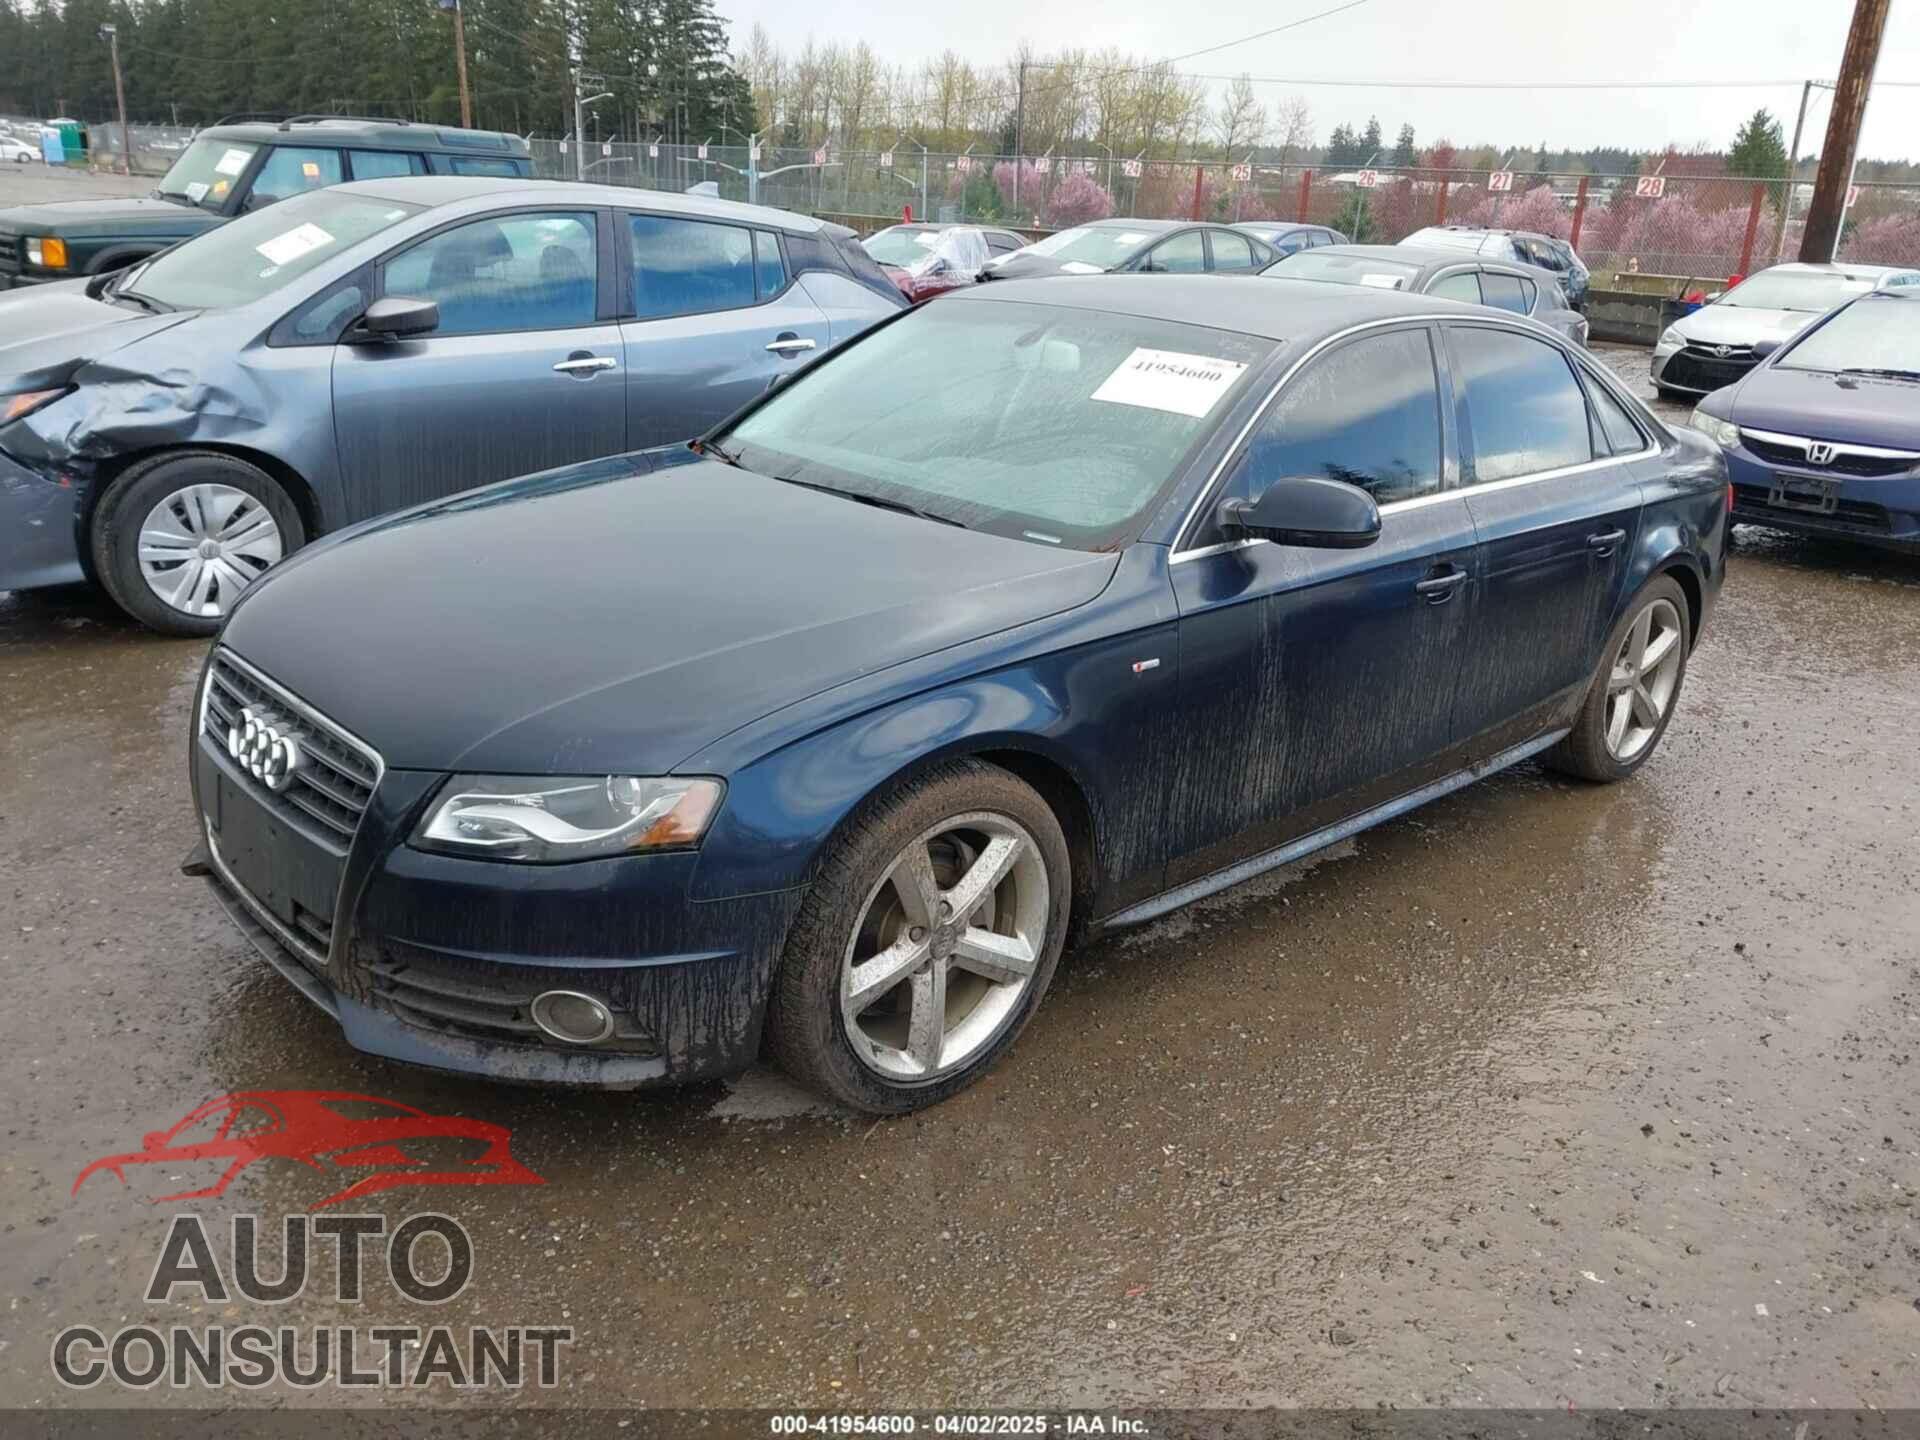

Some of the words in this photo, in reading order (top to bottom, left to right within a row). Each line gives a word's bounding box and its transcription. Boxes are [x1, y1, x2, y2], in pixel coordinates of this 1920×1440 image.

[1235, 166, 1249, 180] 25
[1360, 171, 1375, 186] 26
[1492, 173, 1509, 189] 27
[1639, 178, 1661, 195] 28
